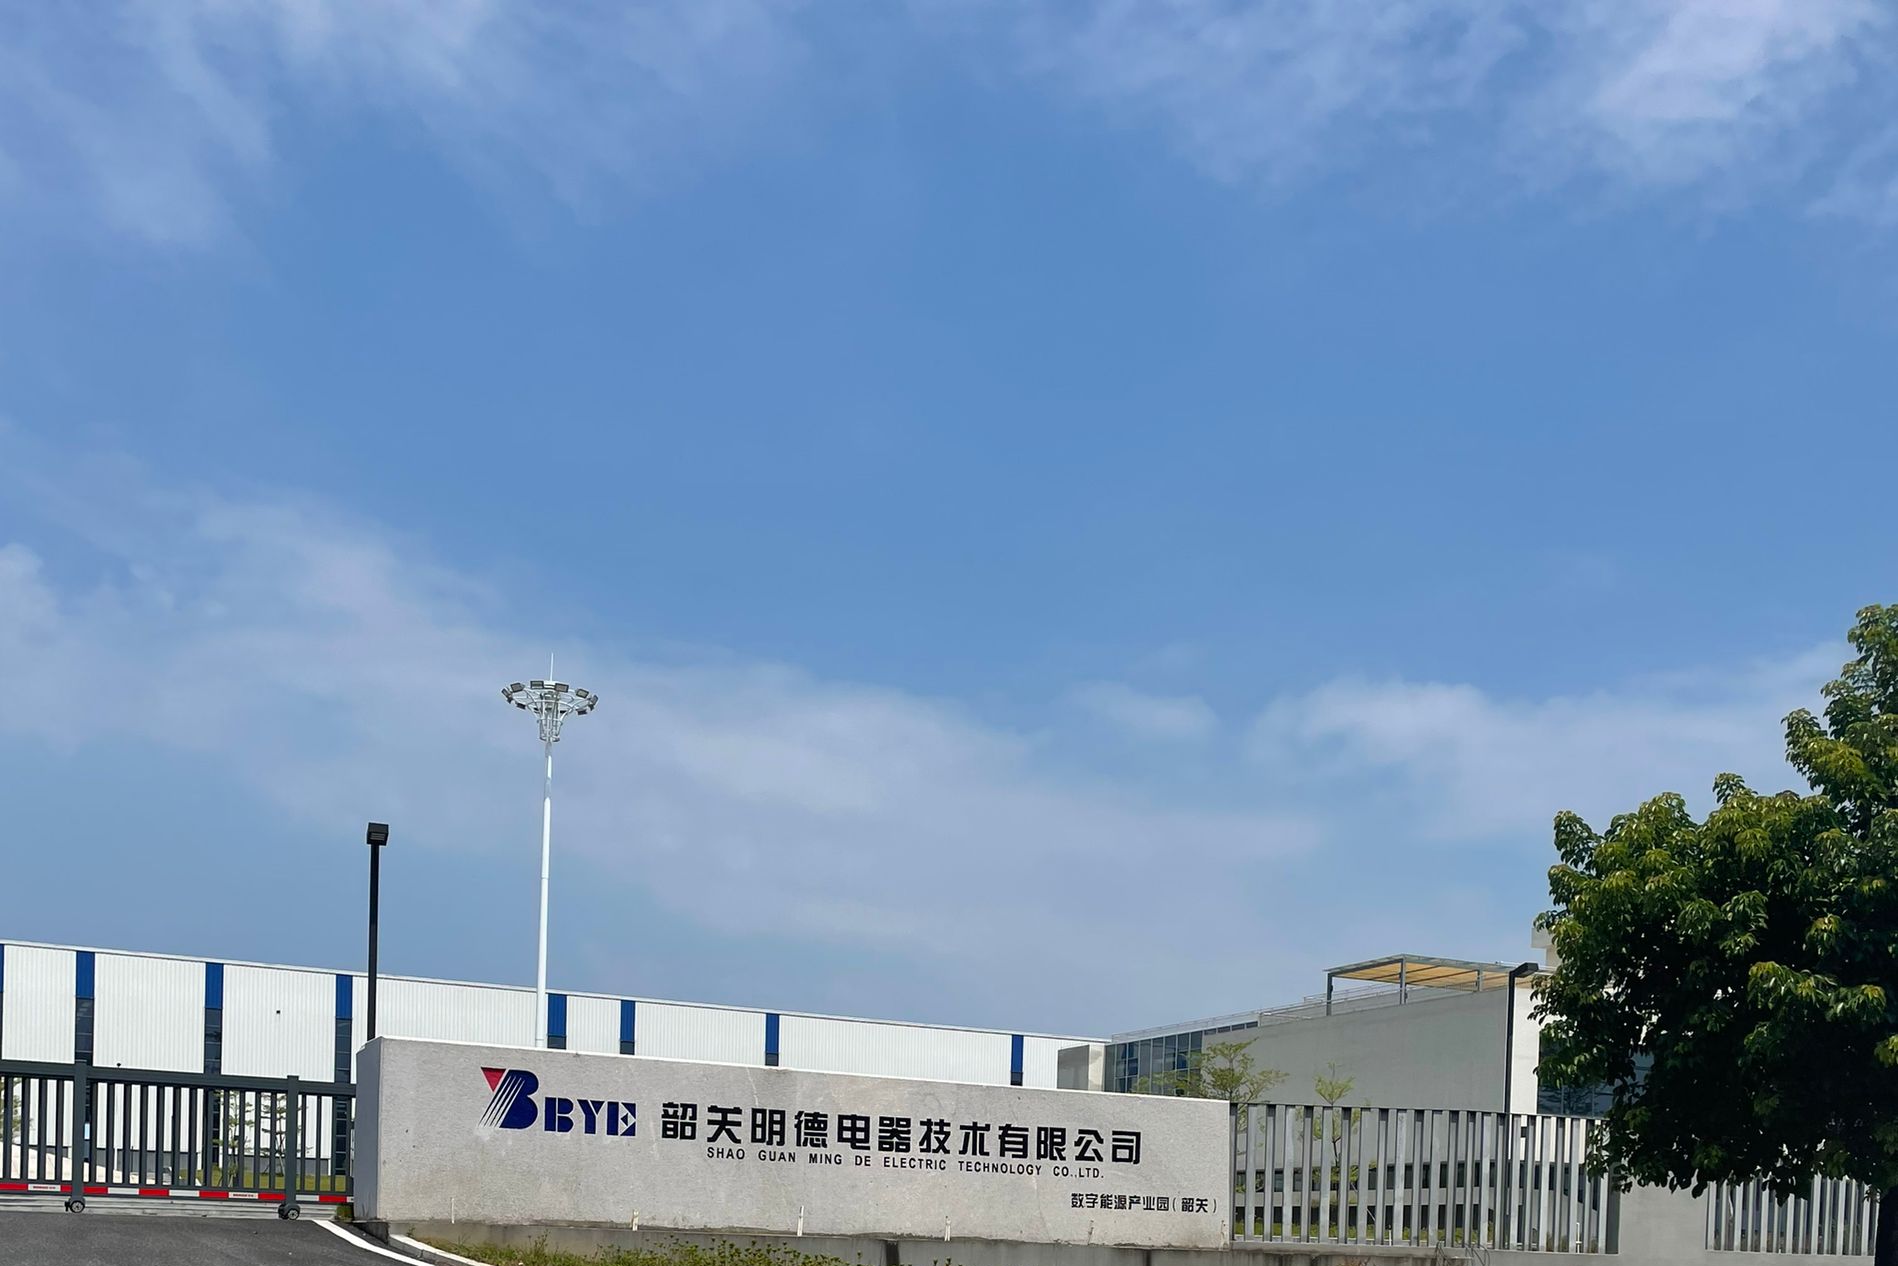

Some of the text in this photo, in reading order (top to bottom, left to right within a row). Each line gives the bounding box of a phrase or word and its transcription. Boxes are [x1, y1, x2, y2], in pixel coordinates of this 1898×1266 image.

[544, 1096, 637, 1137] BYE
[661, 1101, 1142, 1165] 韶关明德电器技术有限公司
[706, 1146, 746, 1160] SHAO
[757, 1149, 797, 1163] GUAN
[808, 1153, 843, 1165] MING
[854, 1155, 872, 1167] DE
[883, 1156, 947, 1171] ELECTRIC
[957, 1160, 1042, 1176] TECHNOLOGY
